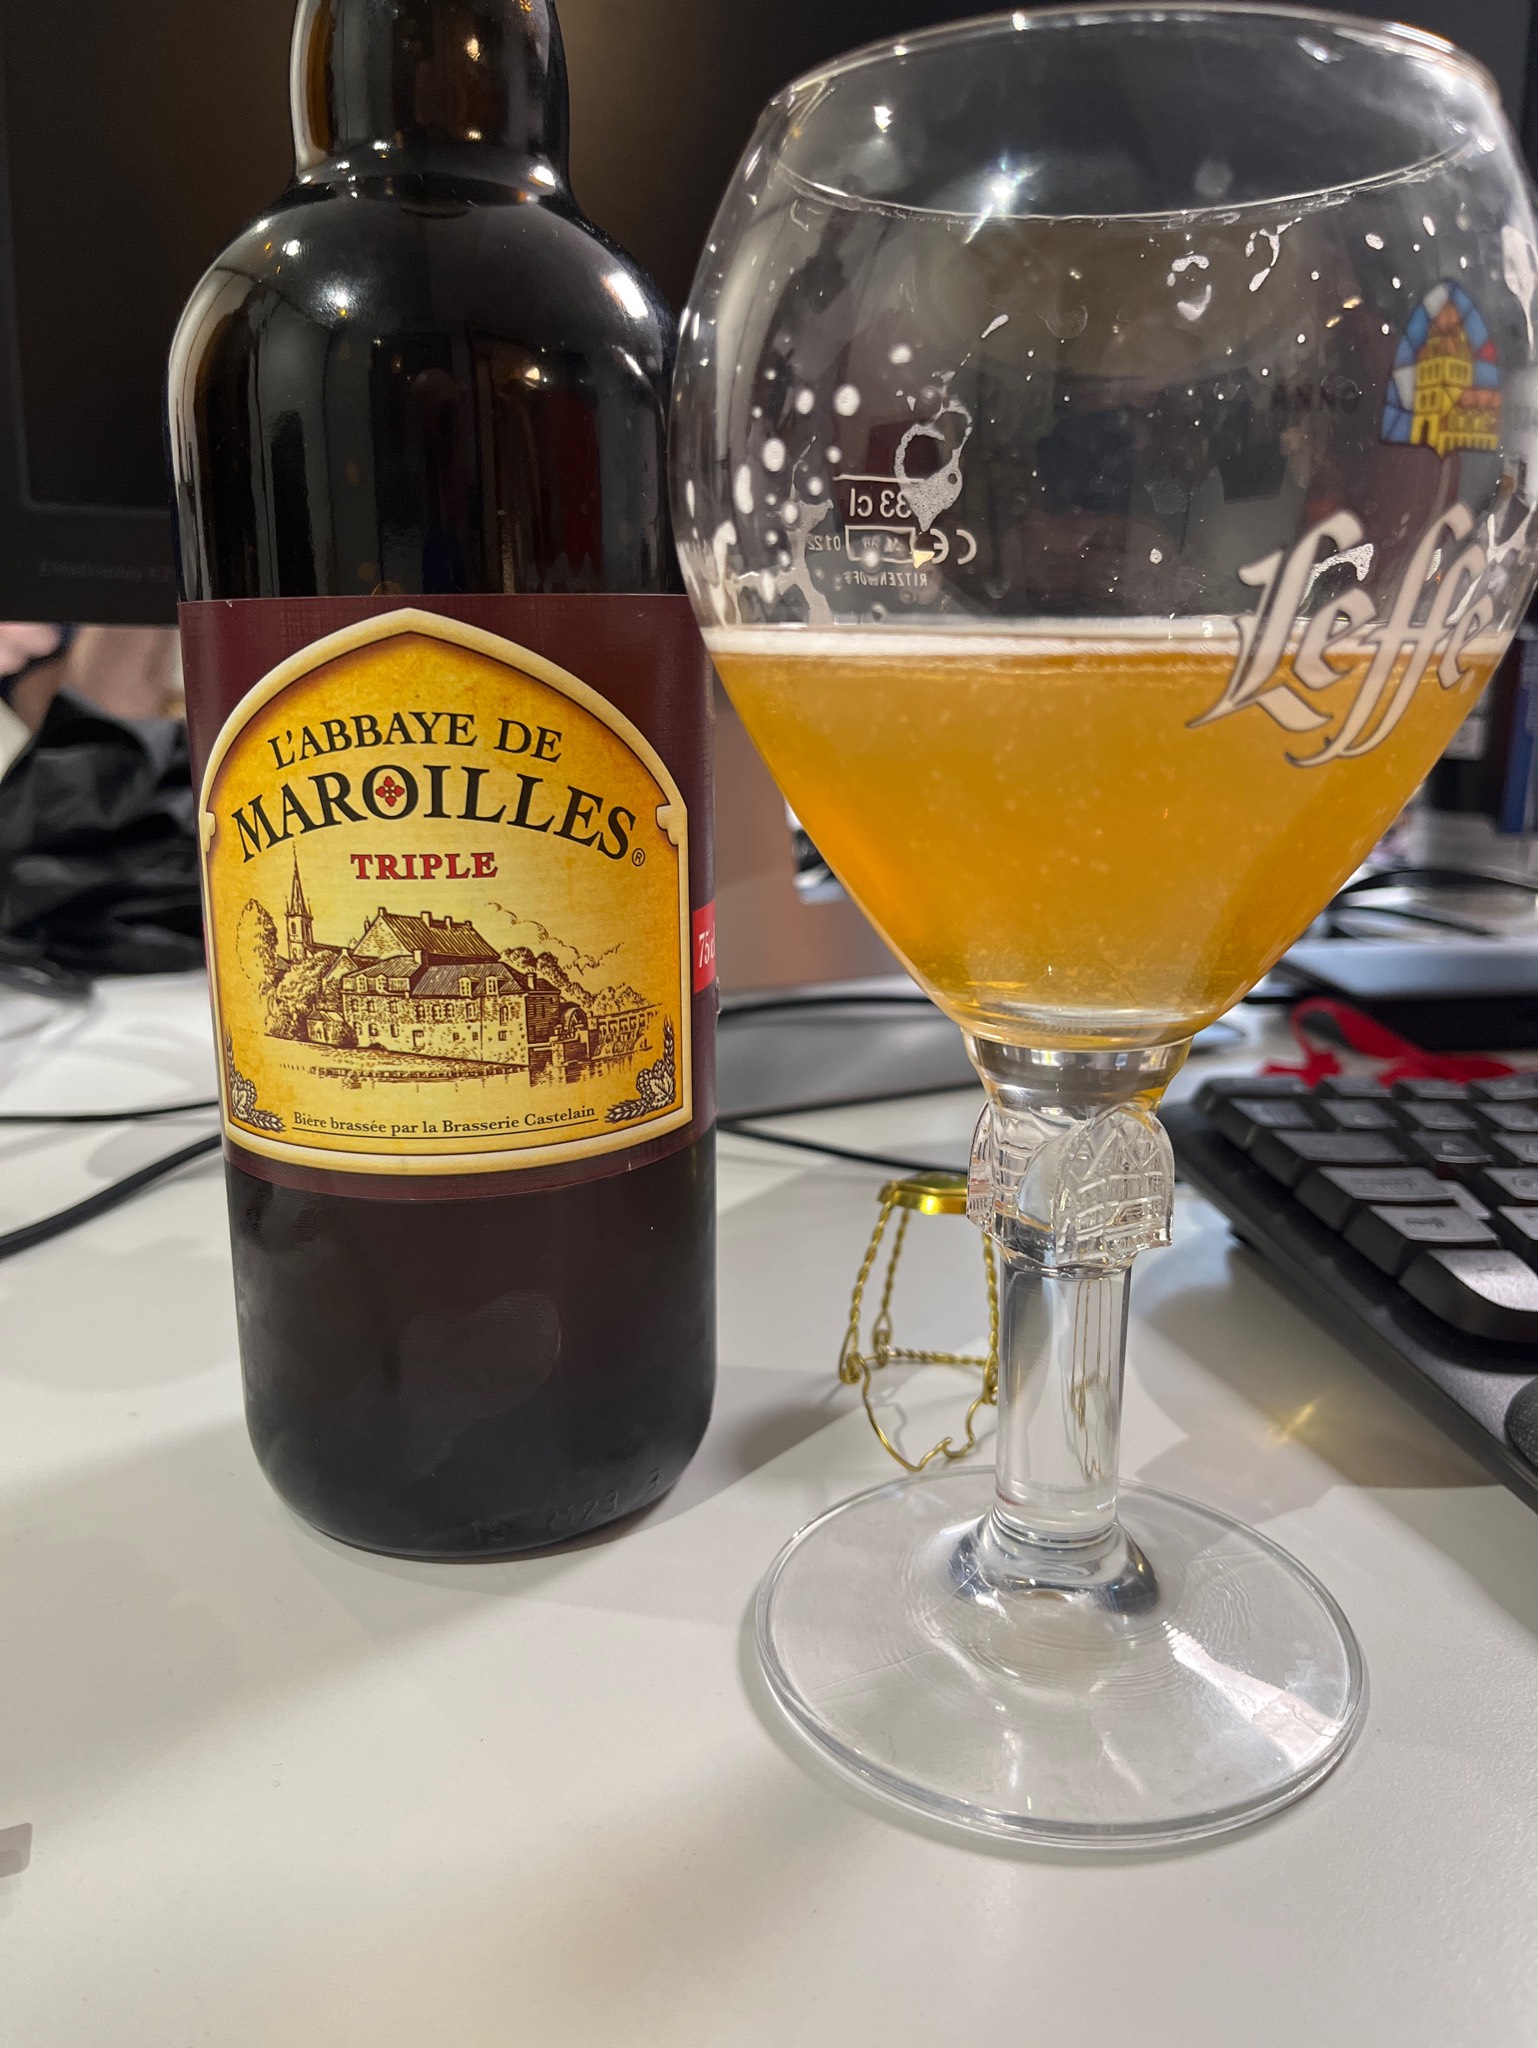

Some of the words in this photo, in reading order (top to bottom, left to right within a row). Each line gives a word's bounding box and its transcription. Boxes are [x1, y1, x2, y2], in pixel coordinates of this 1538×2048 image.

[1185, 502, 1495, 768] Leffe
[267, 711, 477, 770] L'ABBAYE
[495, 716, 563, 764] DE
[231, 763, 637, 863] MAROILLES
[350, 852, 499, 881] TRIPLE
[293, 1111, 327, 1128] Bière
[331, 1117, 387, 1133] brassée
[391, 1122, 417, 1136] par
[422, 1120, 438, 1134] la
[442, 1116, 520, 1133] Brasserie
[523, 1105, 596, 1126] Castelain
